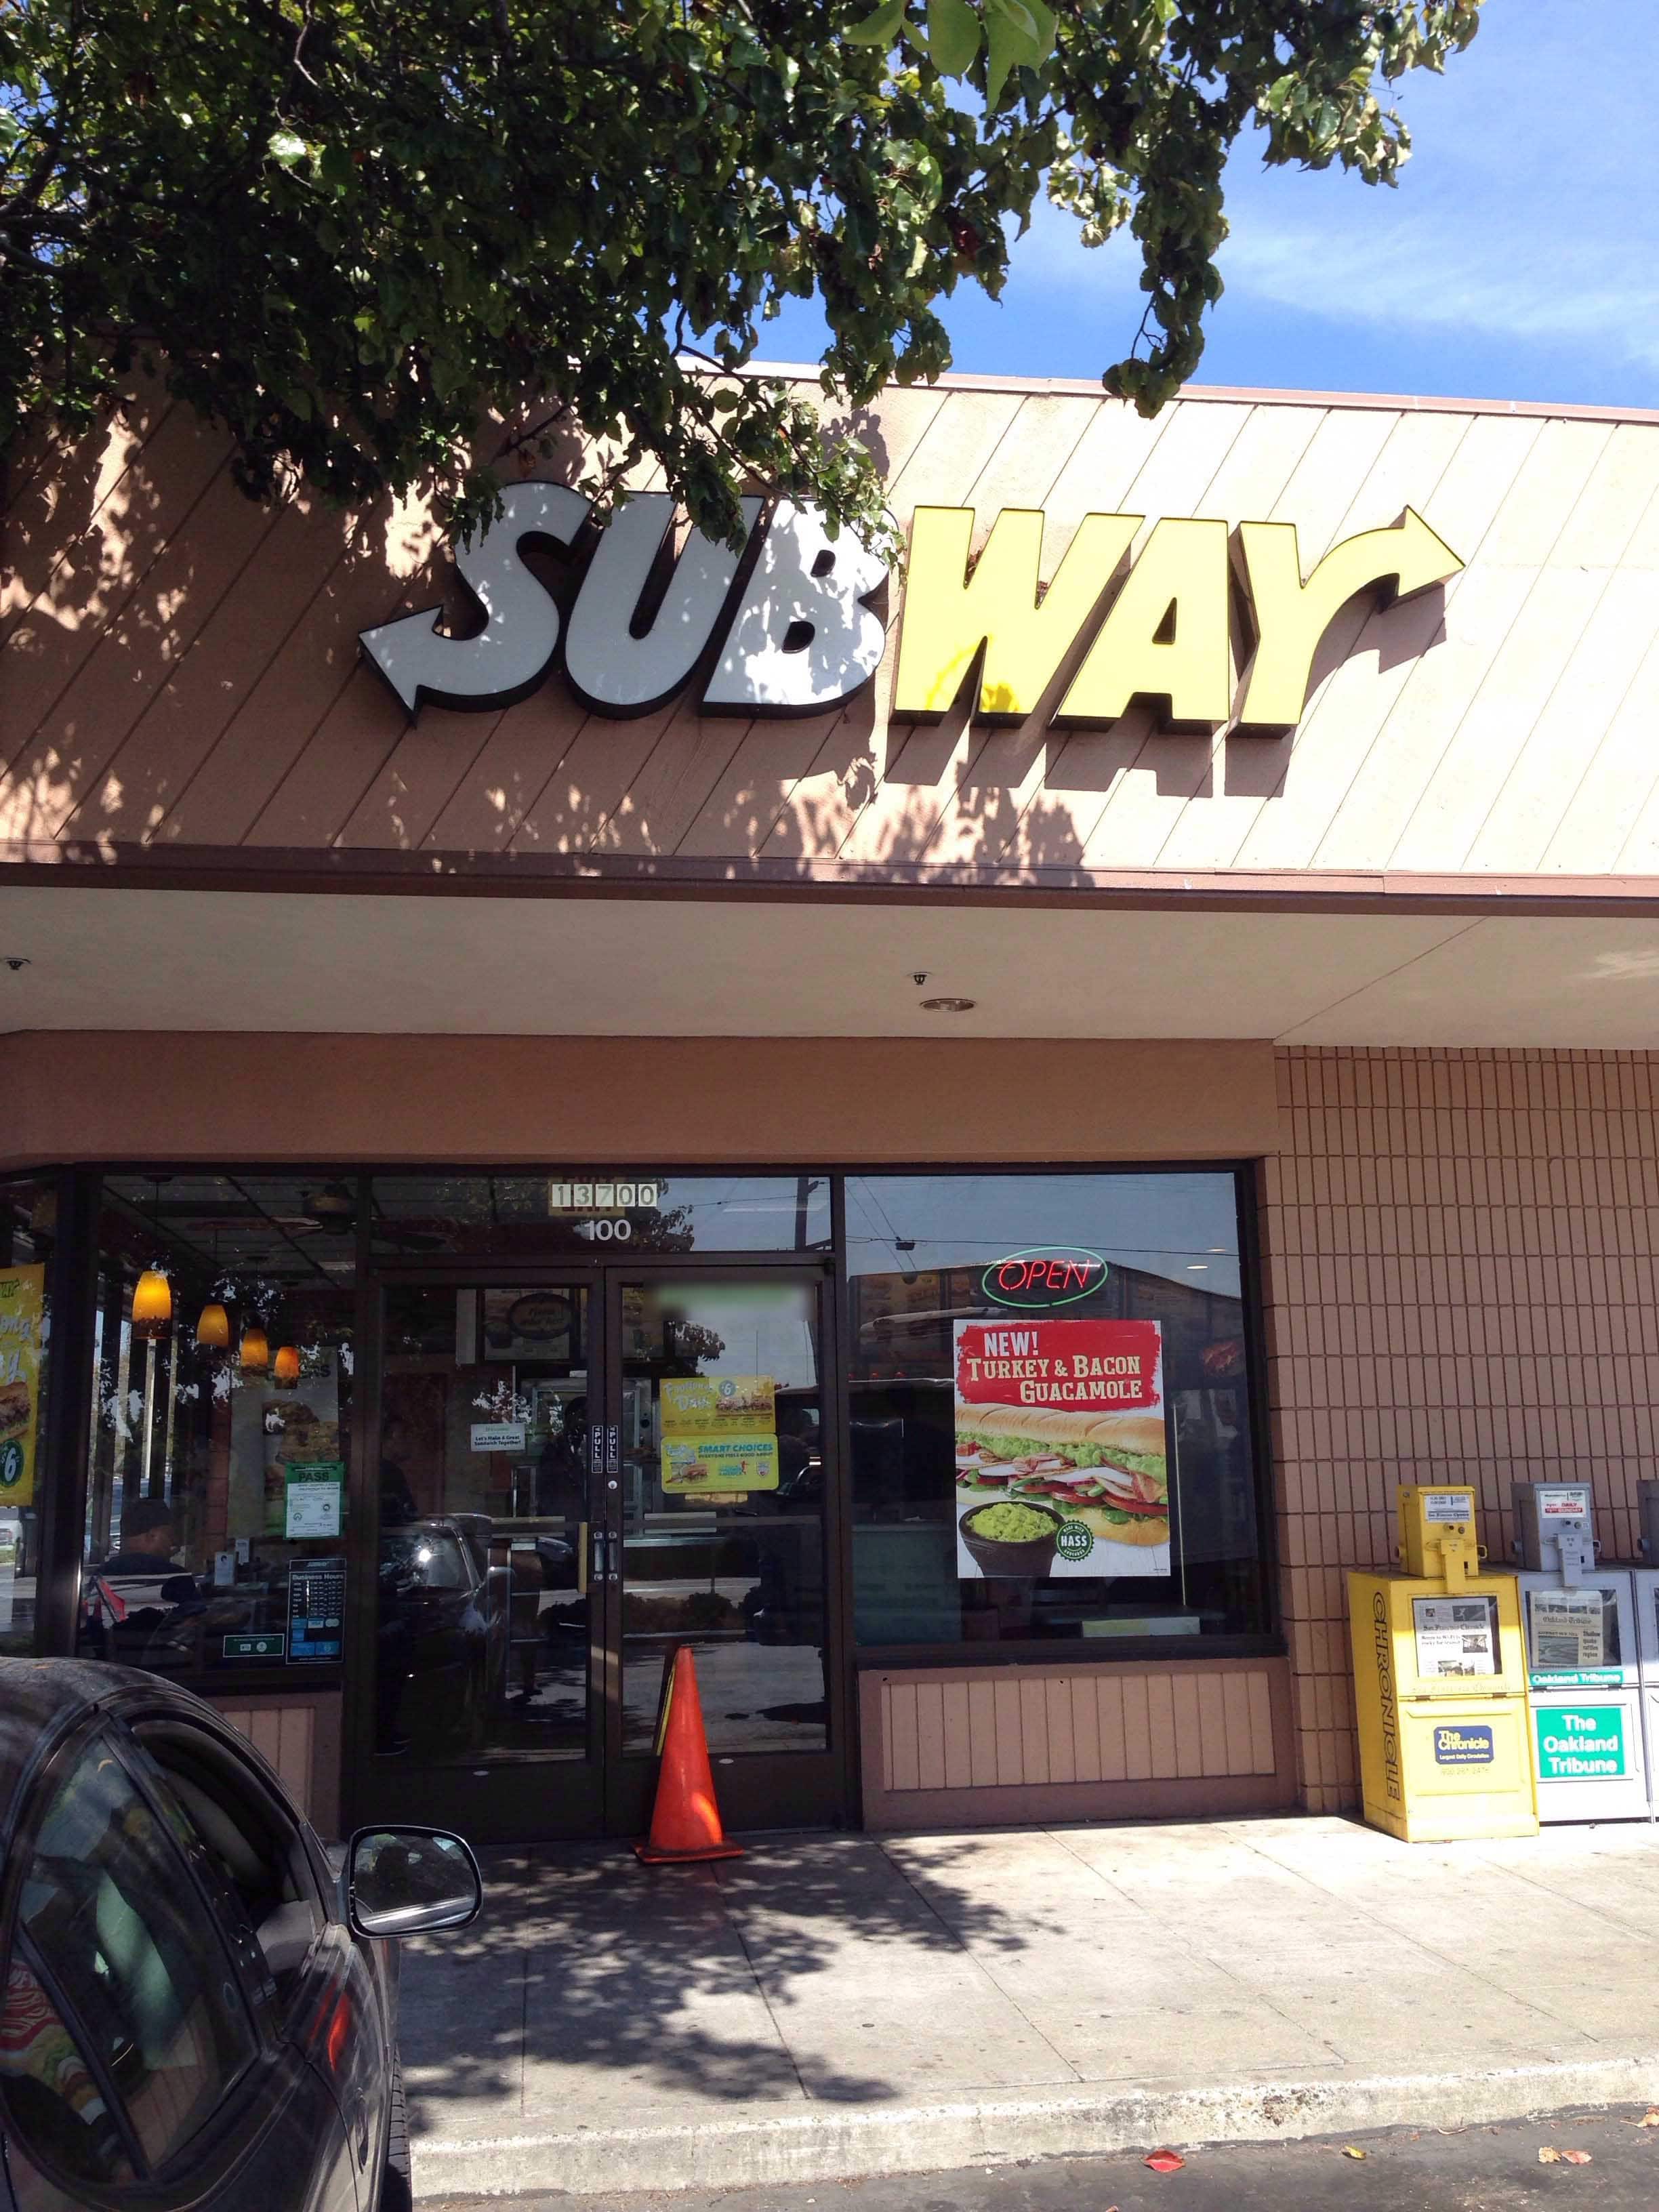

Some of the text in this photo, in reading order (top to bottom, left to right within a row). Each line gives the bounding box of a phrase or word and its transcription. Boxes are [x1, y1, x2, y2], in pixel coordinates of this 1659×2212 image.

[359, 482, 1465, 724] SUBWAY
[554, 1185, 655, 1206] 13700
[586, 1220, 631, 1240] 100
[999, 1259, 1090, 1290] OPEN
[984, 1331, 1038, 1357] NEW!
[966, 1355, 1141, 1381] TURKEY & BACON
[1020, 1380, 1143, 1404] GUACAMOLE
[698, 1443, 773, 1453] SMART CHOICES
[298, 1471, 329, 1482] PASS
[1061, 1535, 1087, 1547] HASS
[1532, 1673, 1621, 1683] Oakland Tribune
[1373, 1592, 1401, 1801] CHRONICLE
[1561, 1715, 1597, 1731] The
[1438, 1730, 1460, 1742] The
[1438, 1738, 1490, 1750] Chronicle
[1543, 1735, 1618, 1753] Oakland
[1548, 1757, 1618, 1774] Tribune
